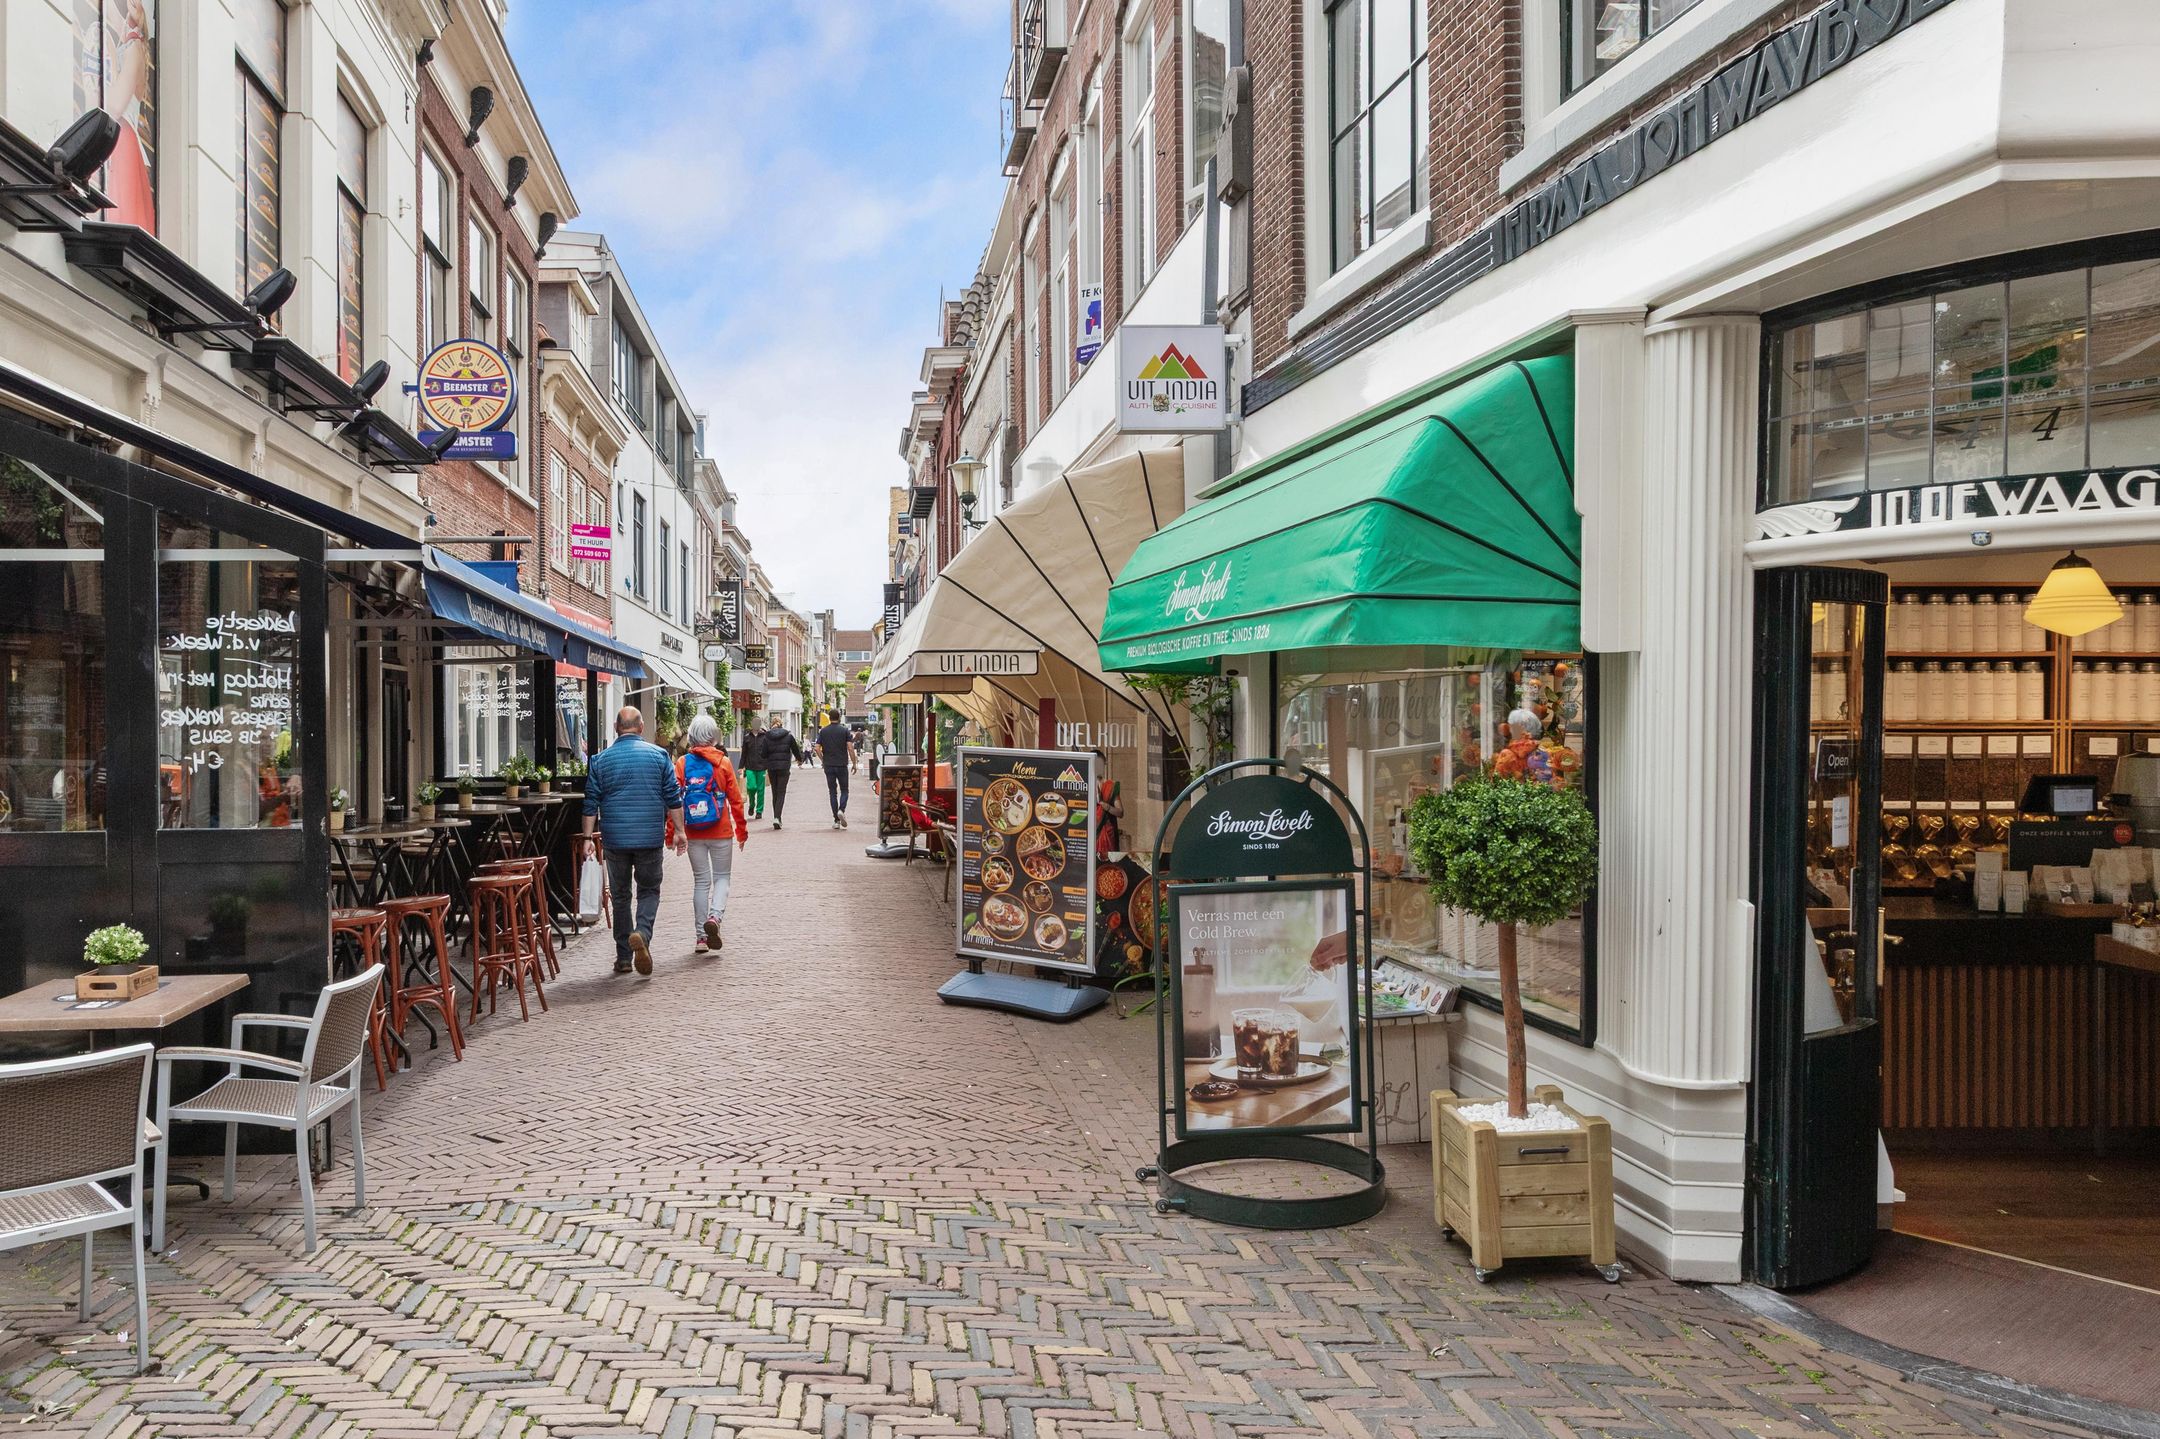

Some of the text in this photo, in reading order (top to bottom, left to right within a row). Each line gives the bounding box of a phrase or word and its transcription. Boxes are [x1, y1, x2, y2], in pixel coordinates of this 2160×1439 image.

[1505, 159, 1607, 264] FIRMA
[1081, 289, 1091, 298] TE
[443, 382, 488, 392] BEEMSTER
[1128, 380, 1217, 400] UIT INDIA
[2032, 406, 2062, 442] 4
[453, 436, 493, 447] EMSTER
[1870, 469, 2160, 529] IN DE WAAG
[1165, 570, 1201, 617] Simon
[885, 604, 900, 640] STRAK
[1126, 624, 1271, 658] PREMIUM BIOLOGISCHE KOFFIE EN THEE SINDS 1826
[940, 654, 1020, 673] UIT INDIA
[1057, 722, 1138, 748] WELKOM
[1012, 761, 1038, 776] Menu
[1827, 754, 1849, 768] Open
[1053, 780, 1088, 791] UIT INDIA
[1207, 808, 1314, 840] Simon Lévelt
[1188, 909, 1285, 922] Verras met een
[963, 933, 994, 946] UIT INDIA
[1189, 925, 1257, 940] Cold Brew
